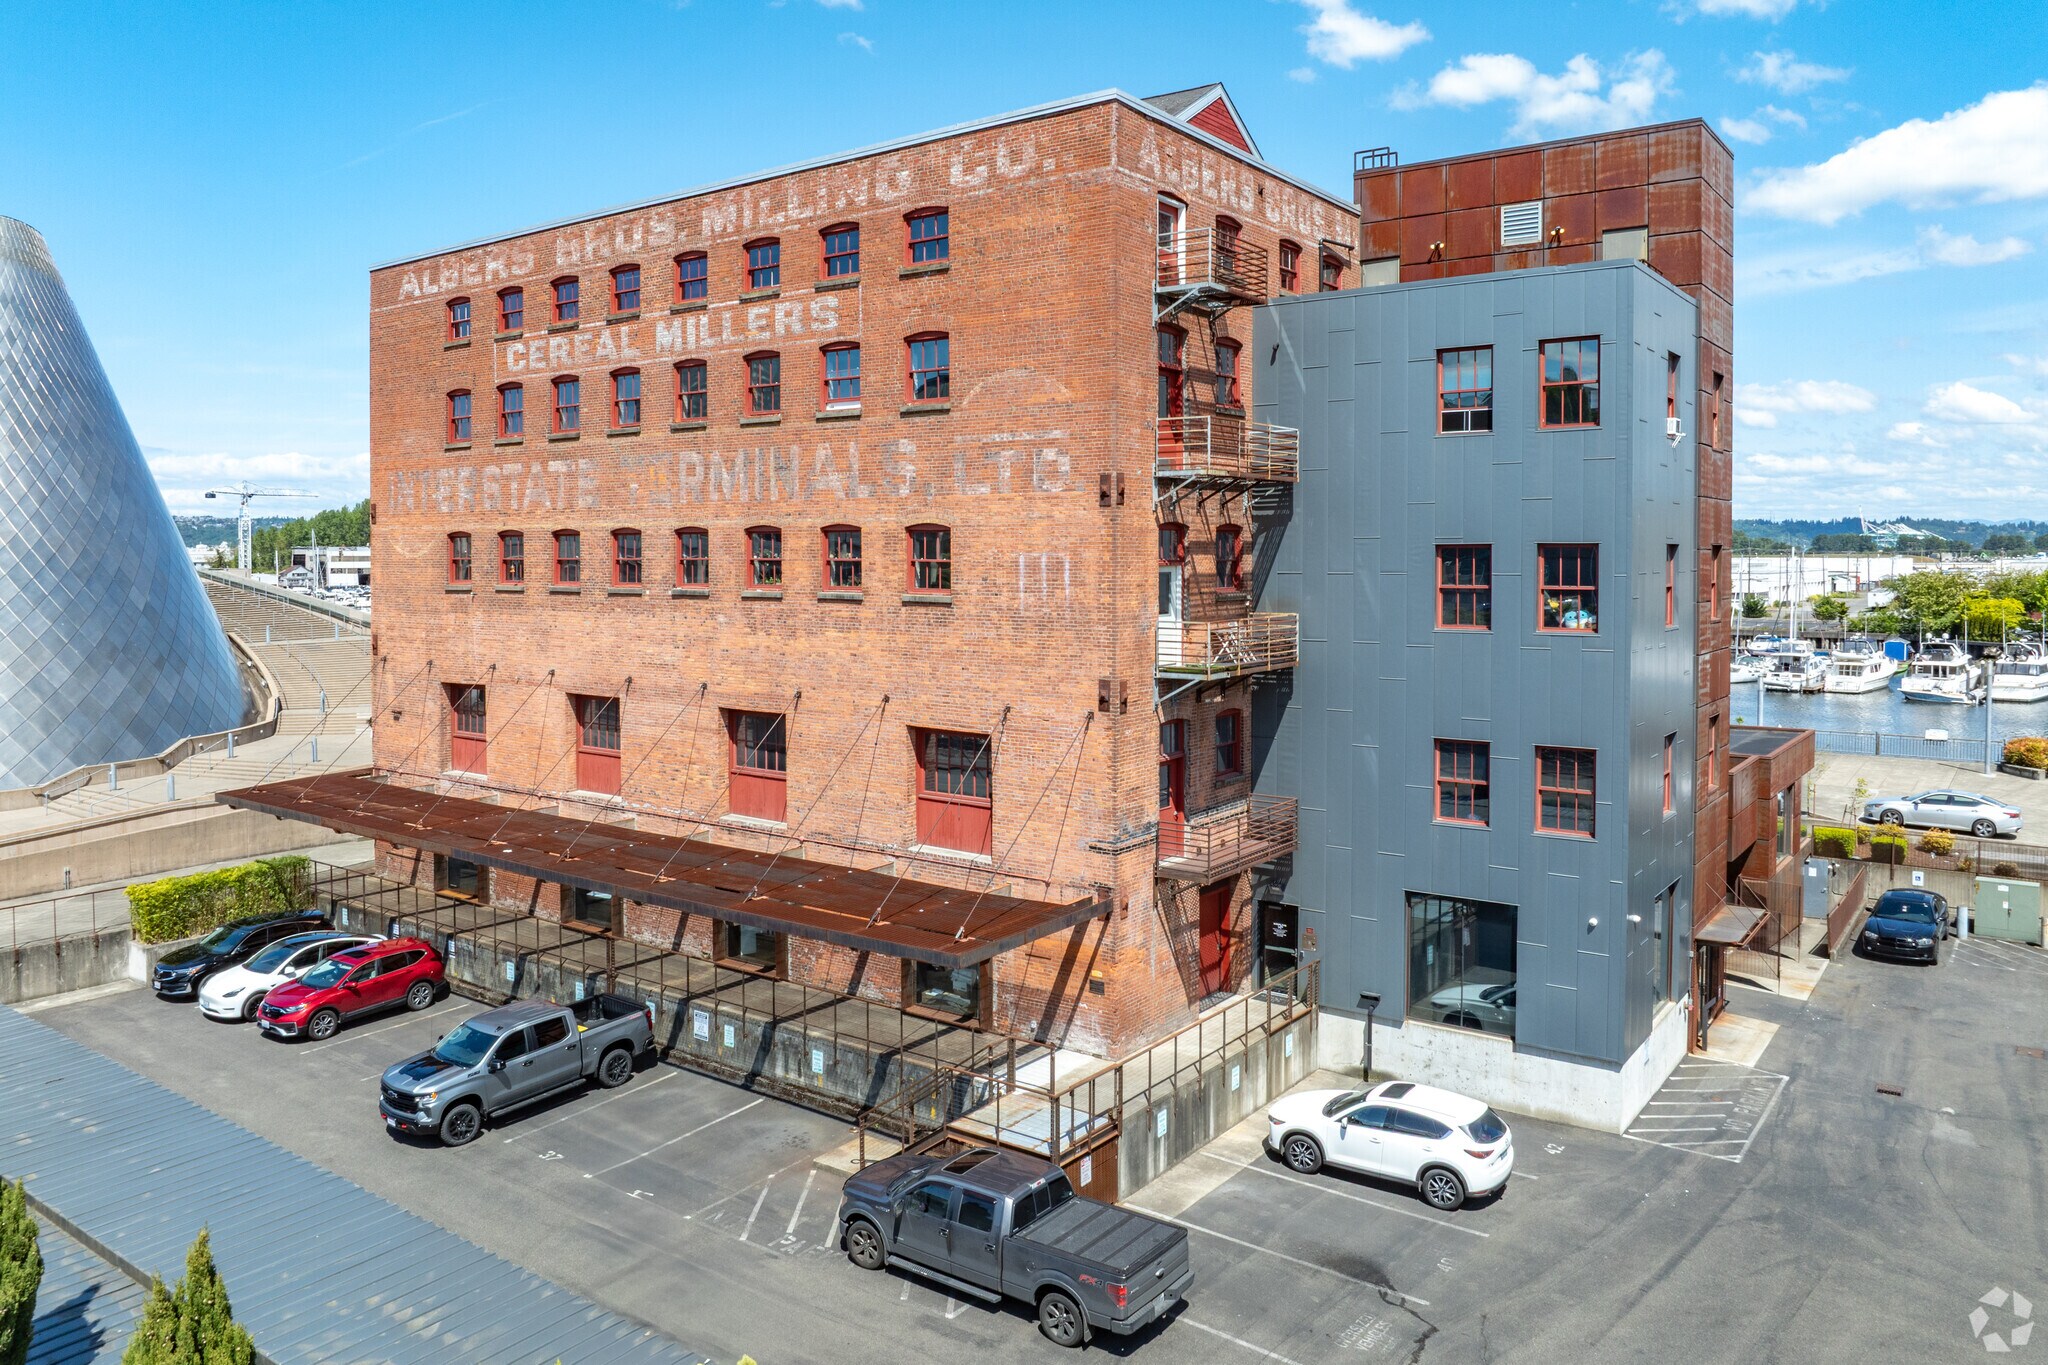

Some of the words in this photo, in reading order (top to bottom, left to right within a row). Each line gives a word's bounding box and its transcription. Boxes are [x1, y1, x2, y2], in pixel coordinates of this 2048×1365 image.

[506, 326, 639, 372] CEREAL
[655, 296, 840, 353] MILLERS
[388, 459, 598, 513] INTERSTATE
